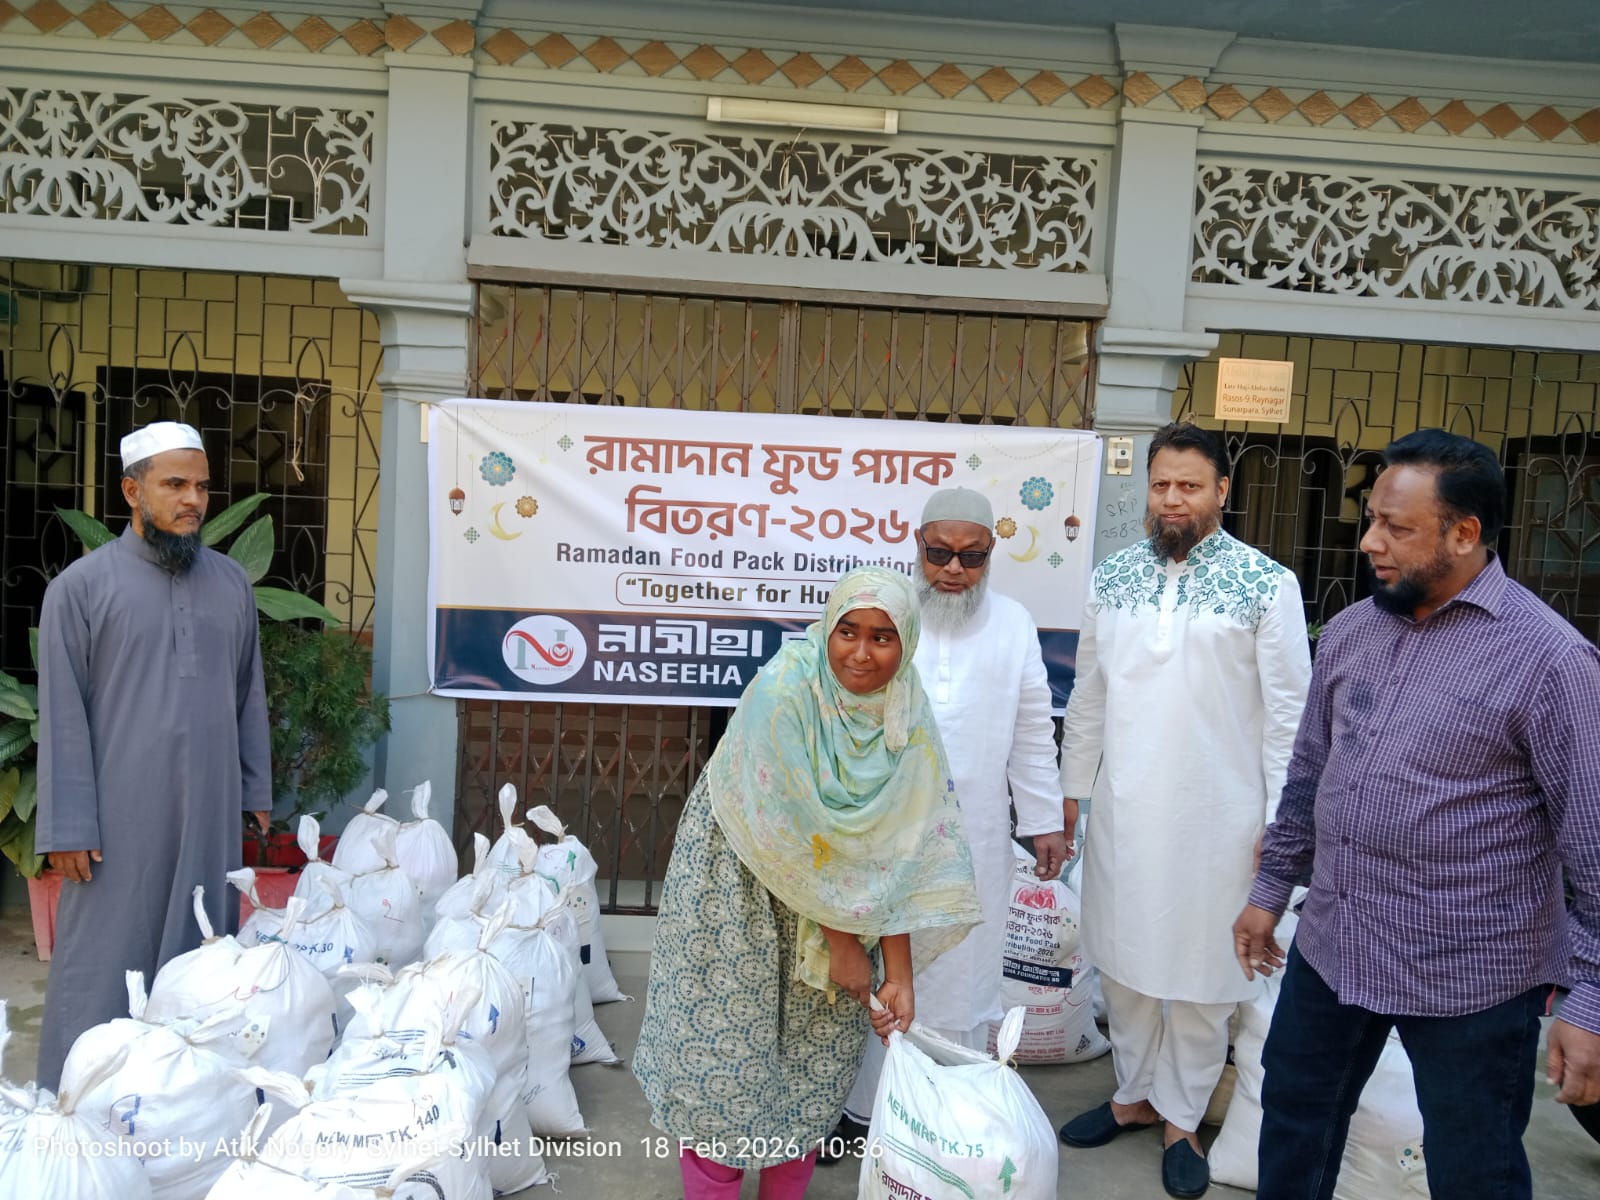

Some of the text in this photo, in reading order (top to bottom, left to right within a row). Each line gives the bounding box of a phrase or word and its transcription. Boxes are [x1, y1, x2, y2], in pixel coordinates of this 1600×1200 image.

[584, 435, 957, 495] রামাদান ফুড প্যাক
[625, 484, 909, 545] বিতরণ-২০২৬
[556, 543, 661, 567] Ramadan
[671, 547, 723, 570] Food
[733, 550, 785, 572] Pack
[756, 583, 791, 603] for
[598, 619, 763, 657] নাসীহা
[593, 660, 743, 686] NASEEHA
[887, 1089, 909, 1125] NEW
[911, 1118, 937, 1144] MRP
